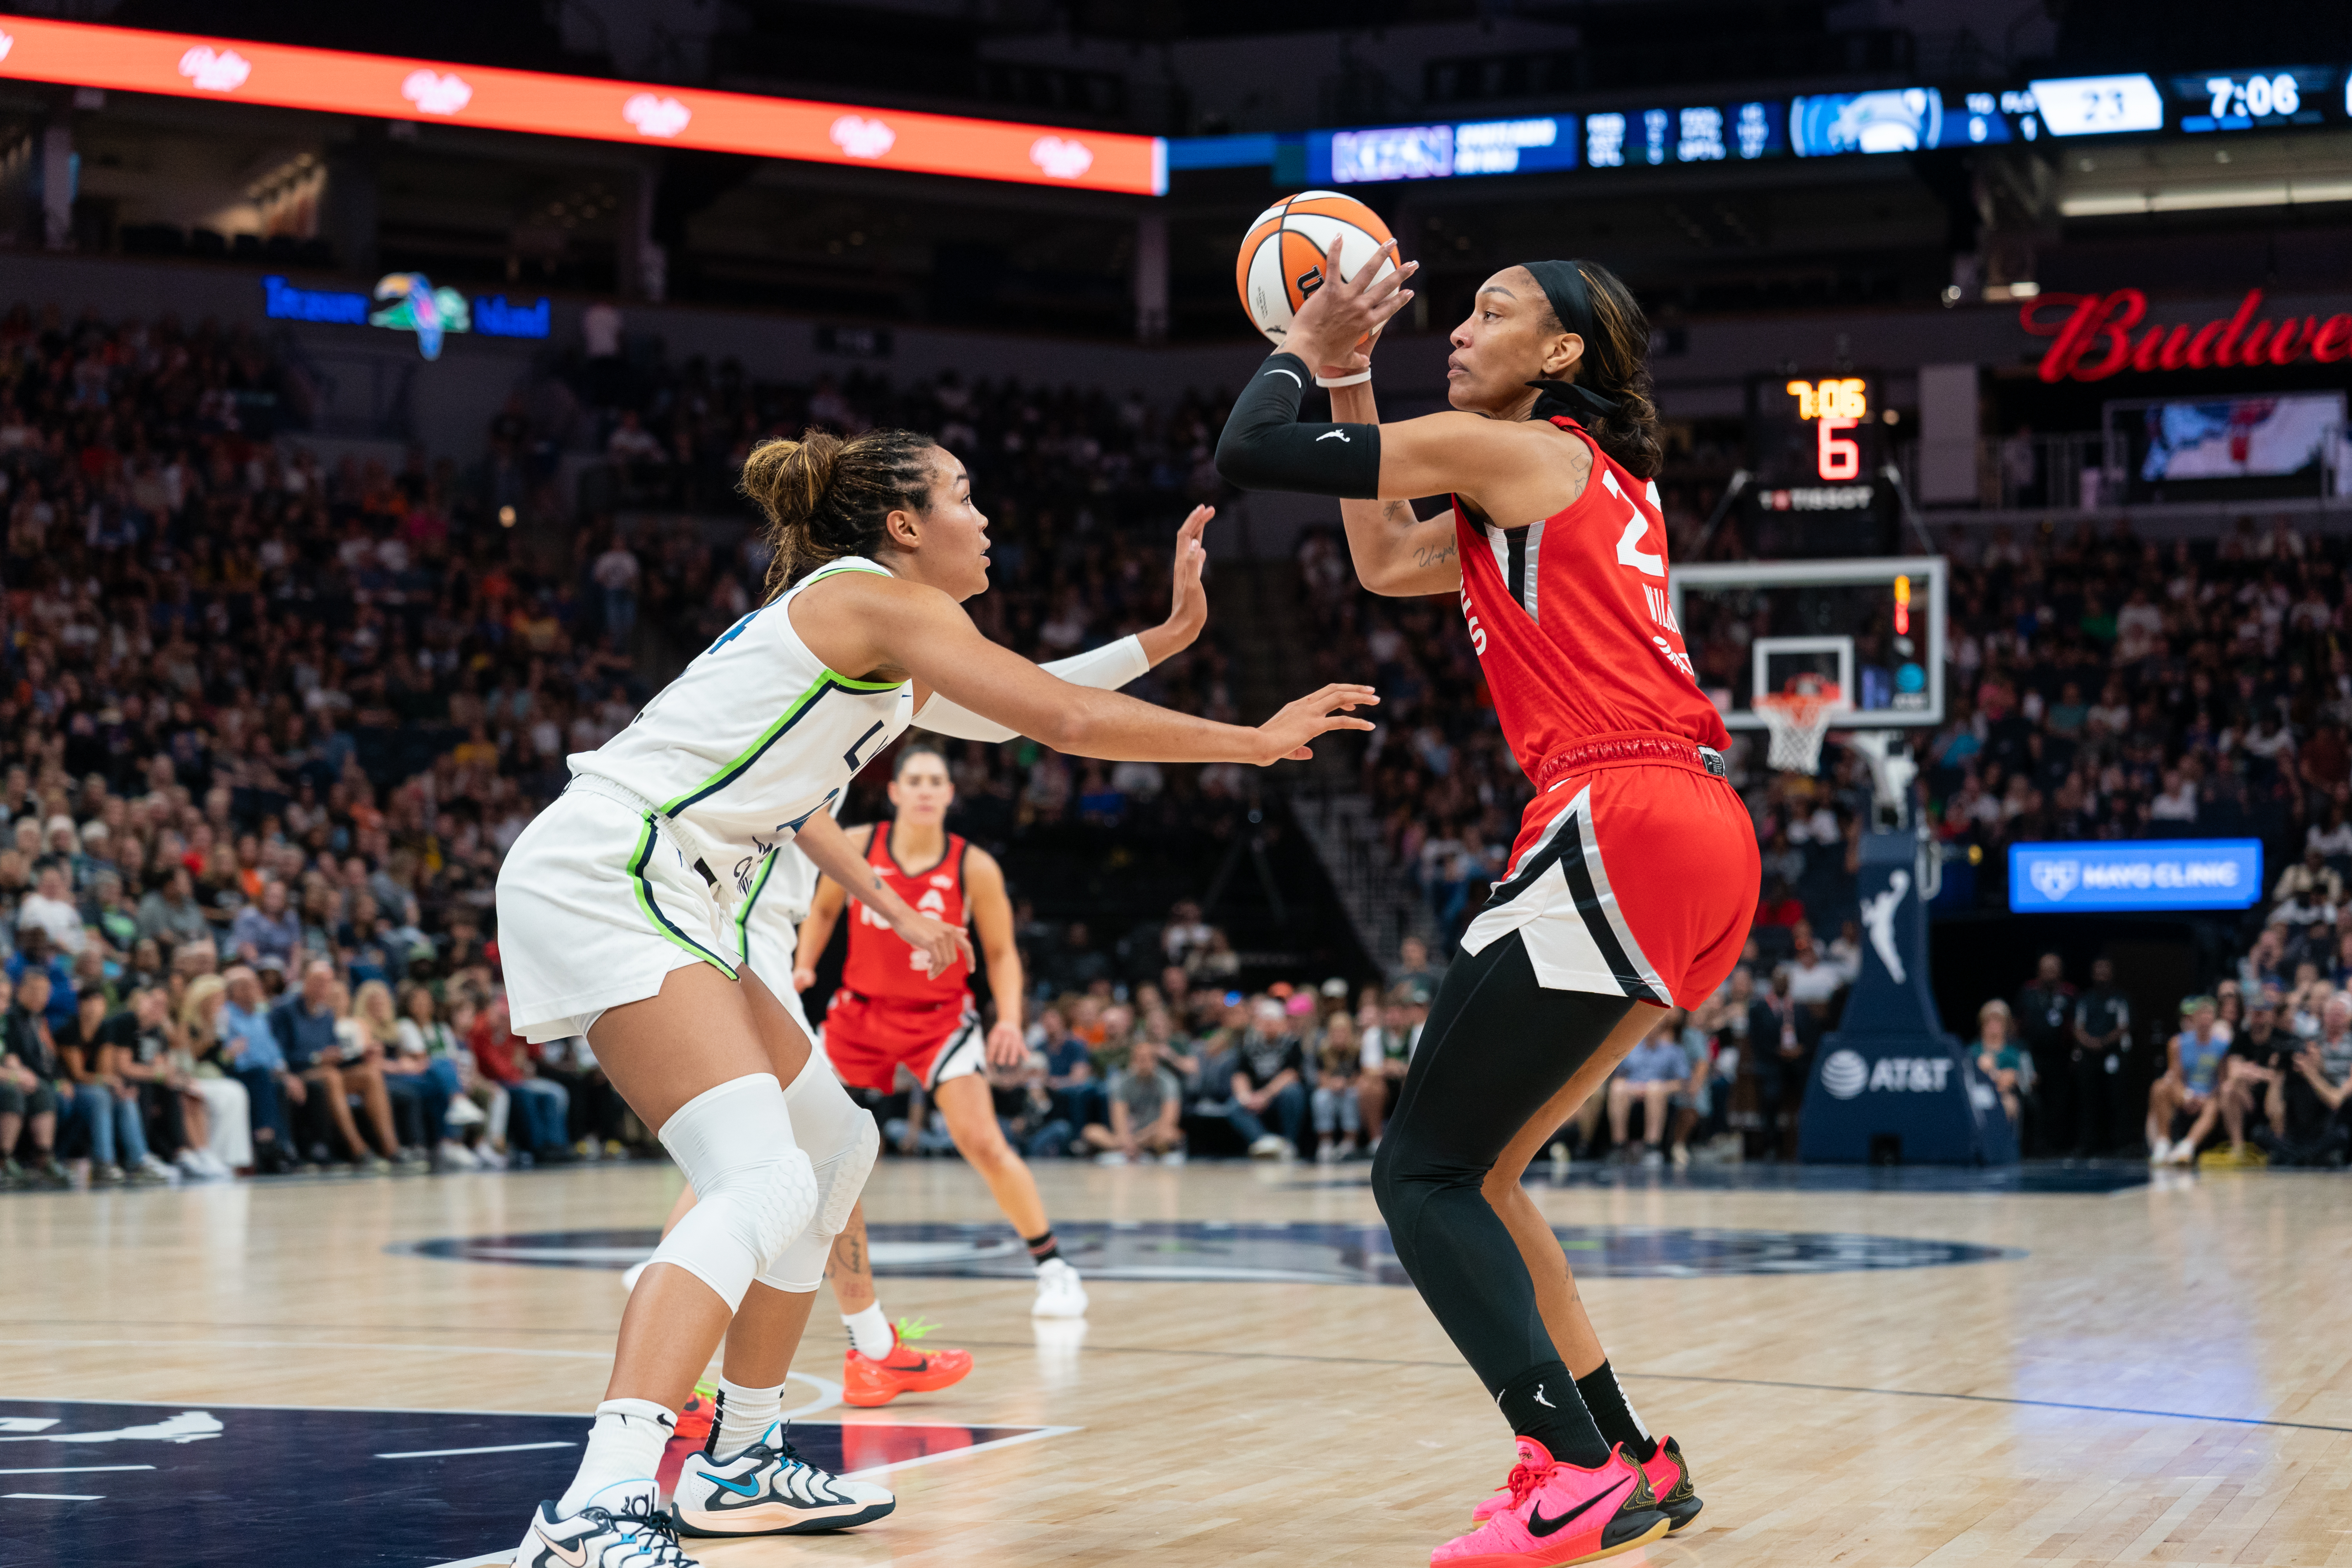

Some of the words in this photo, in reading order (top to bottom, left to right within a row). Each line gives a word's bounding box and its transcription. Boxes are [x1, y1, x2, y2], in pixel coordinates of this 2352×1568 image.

[2206, 72, 2300, 119] 7:06
[1818, 416, 1859, 480] 6
[1869, 1057, 1954, 1093] AT&T
